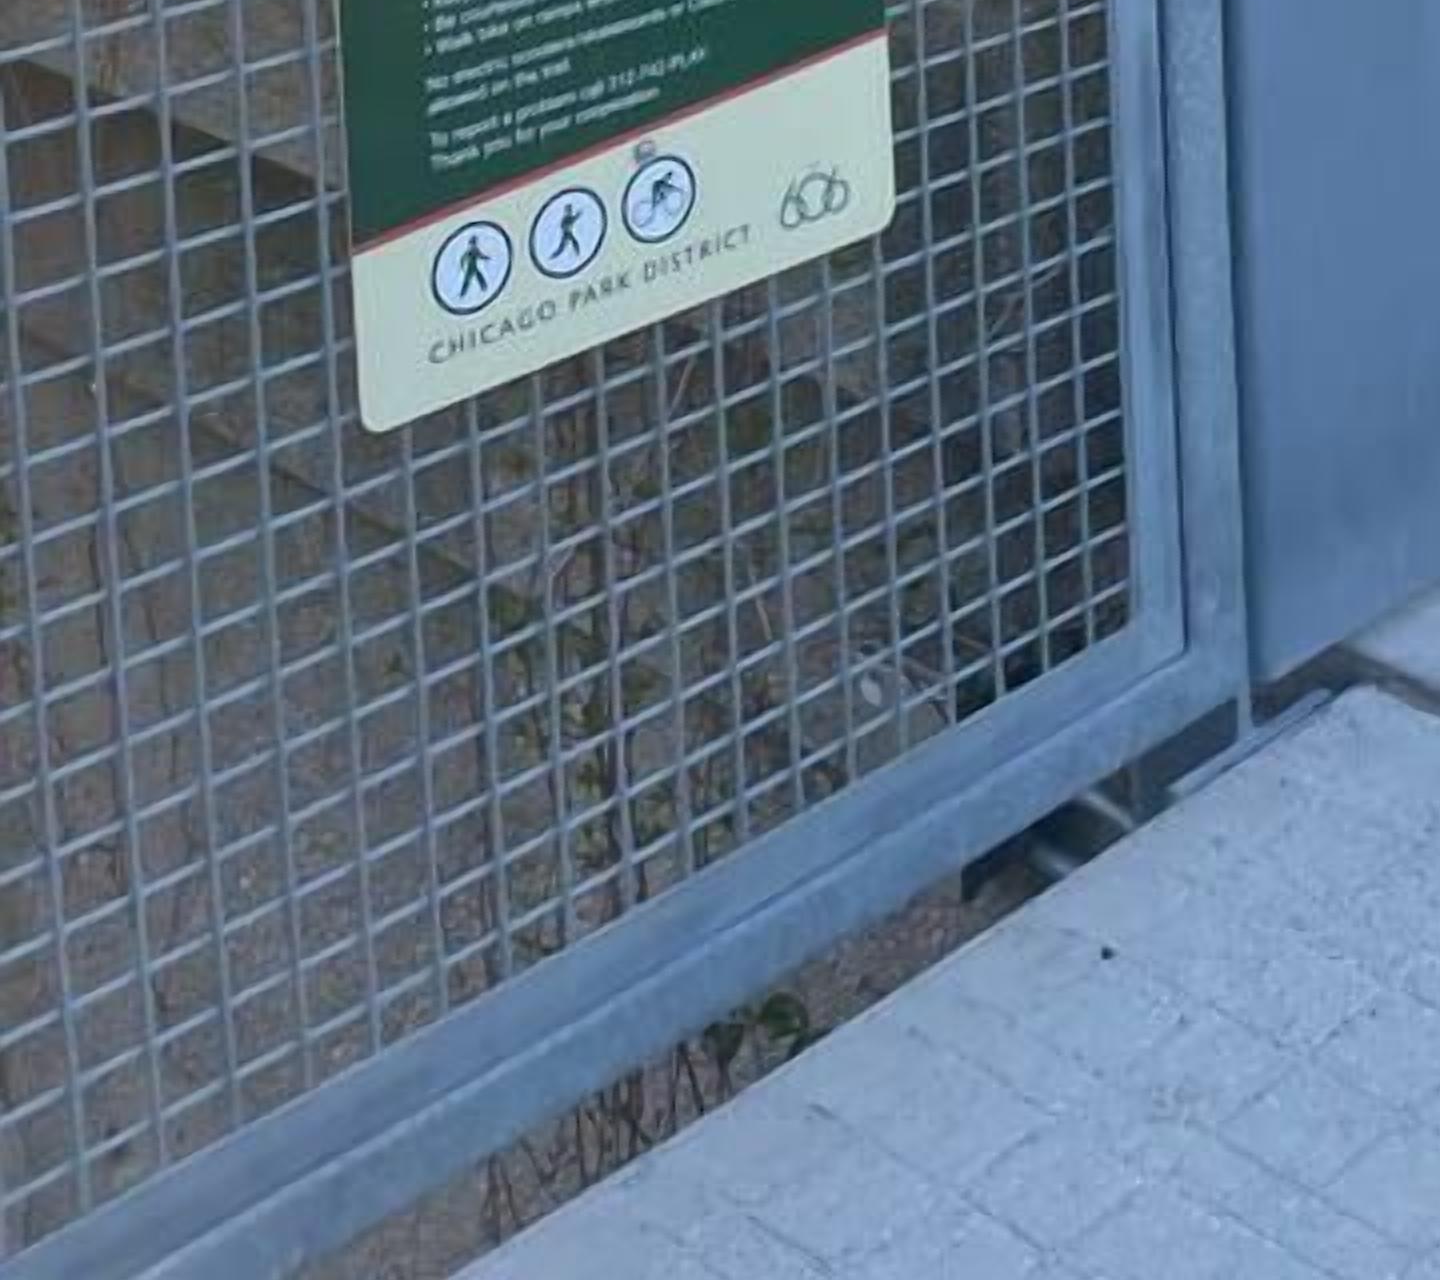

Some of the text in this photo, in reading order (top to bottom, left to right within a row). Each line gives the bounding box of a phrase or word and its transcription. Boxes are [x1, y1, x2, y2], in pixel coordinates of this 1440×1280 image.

[427, 223, 751, 365] CHICAGO PARK DISTRICT
